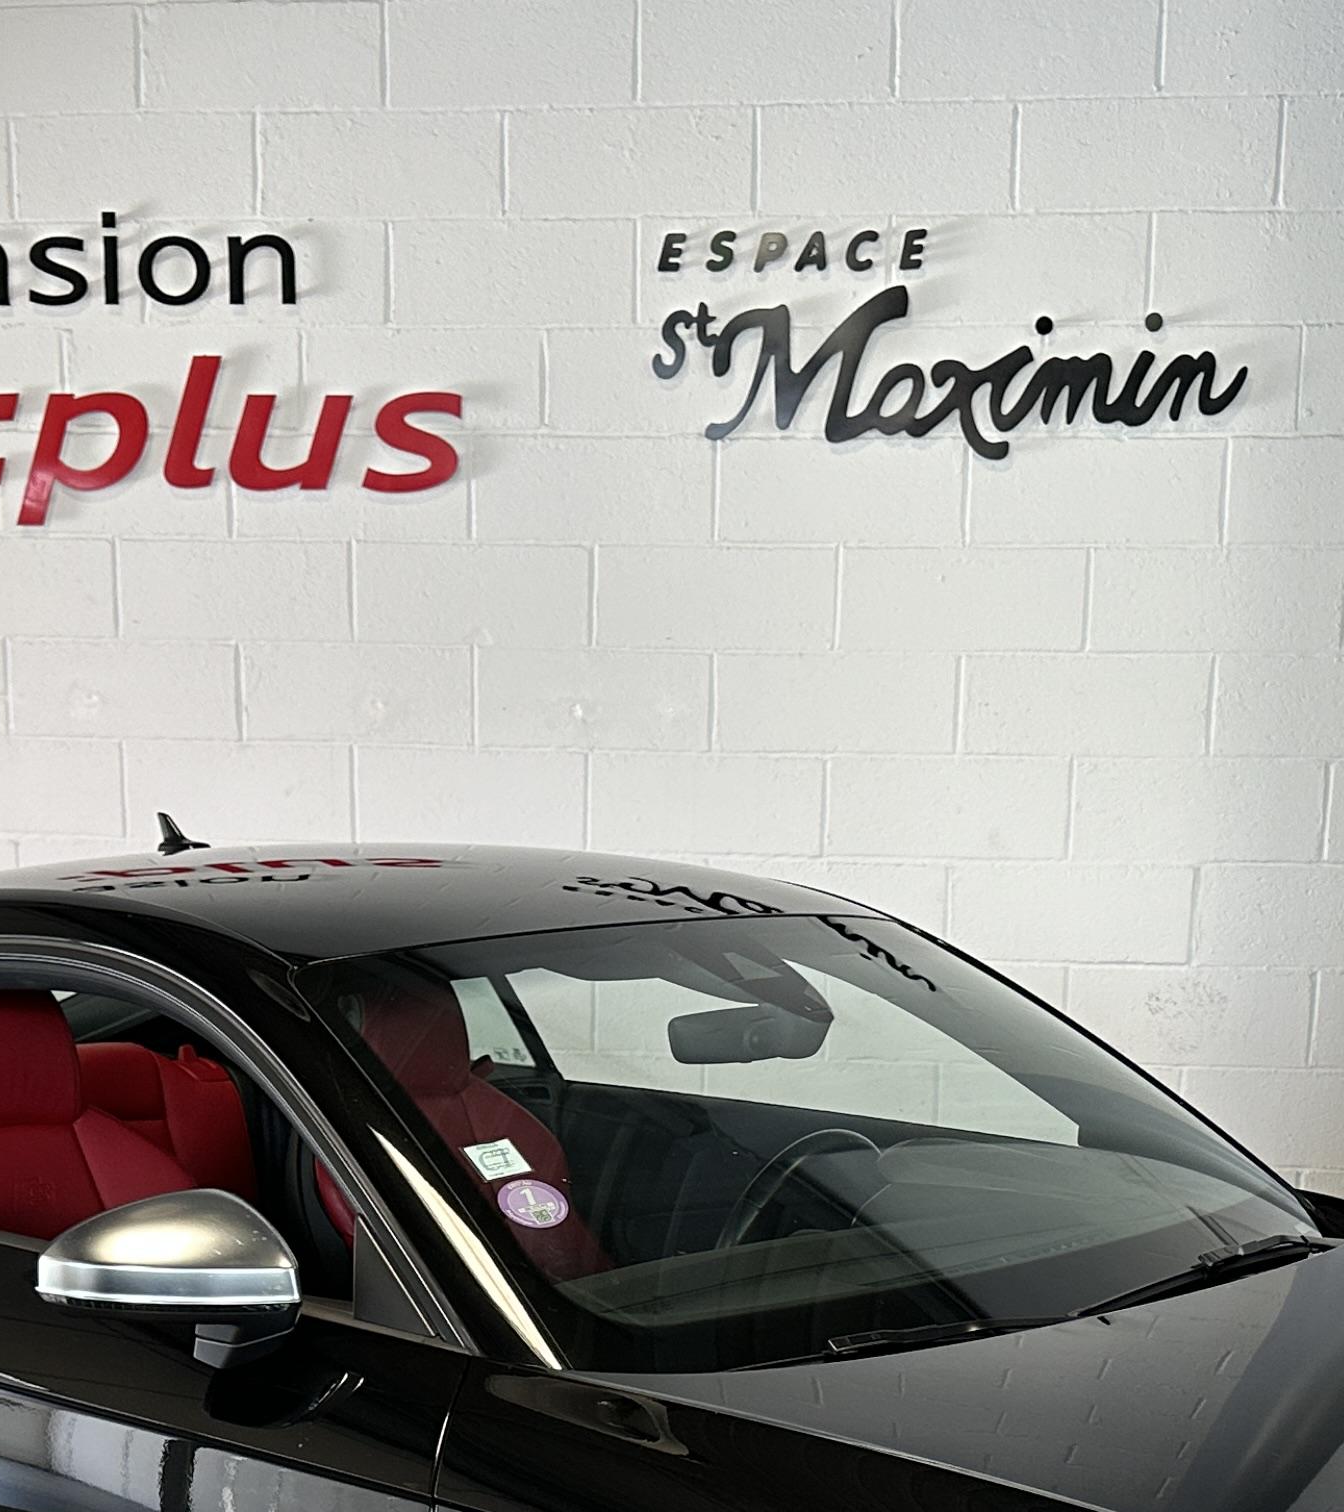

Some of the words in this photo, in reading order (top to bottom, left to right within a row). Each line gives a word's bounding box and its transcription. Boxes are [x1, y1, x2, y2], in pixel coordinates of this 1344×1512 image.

[658, 229, 928, 272] ESPACE
[652, 302, 718, 379] St
[704, 286, 1248, 460] Maximin
